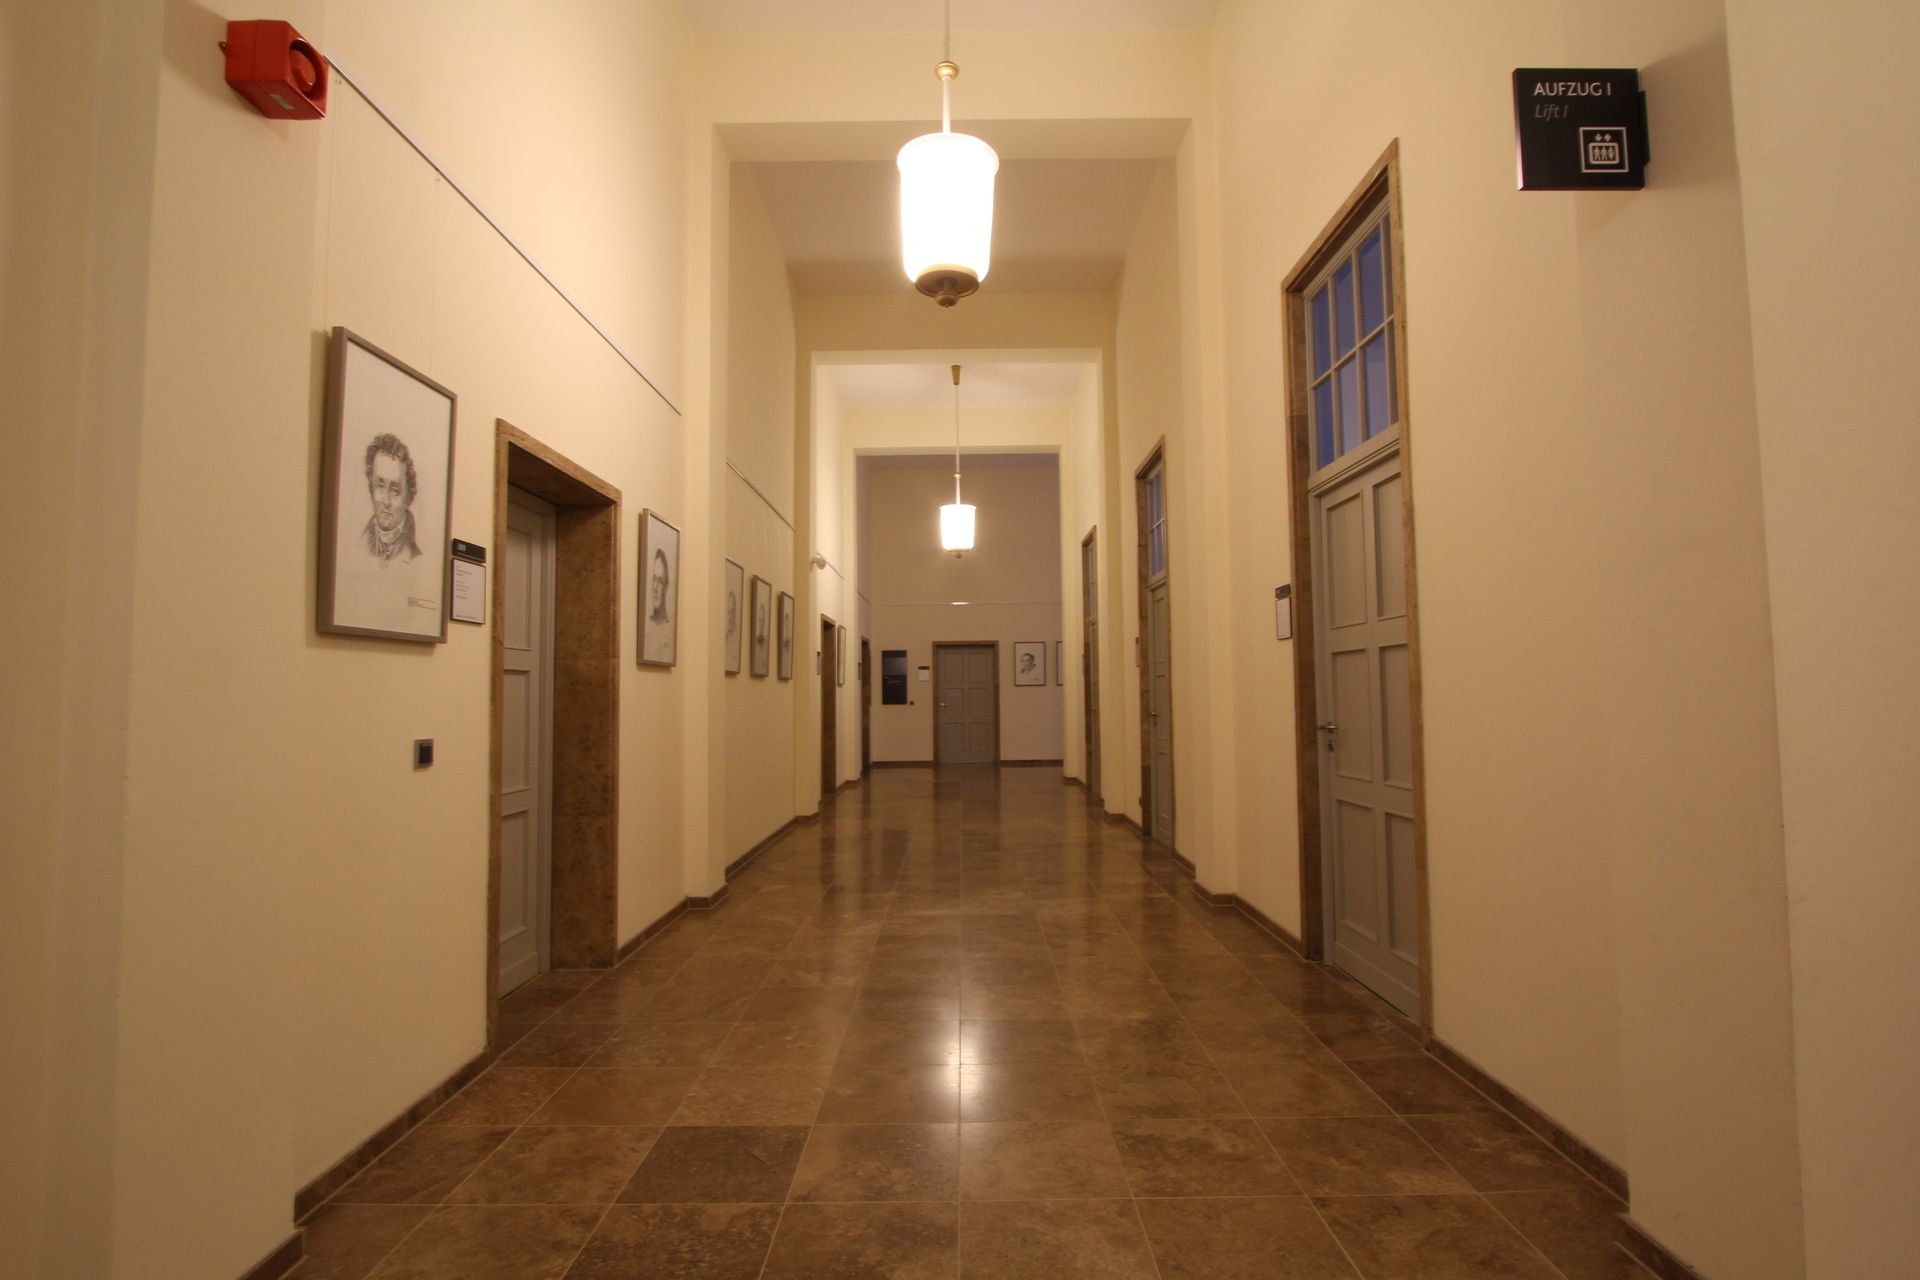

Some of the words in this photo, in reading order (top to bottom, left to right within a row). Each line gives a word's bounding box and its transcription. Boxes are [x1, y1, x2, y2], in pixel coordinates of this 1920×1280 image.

[1533, 82, 1602, 96] AUFZUG
[1607, 82, 1612, 96] I
[1535, 104, 1561, 121] Lift
